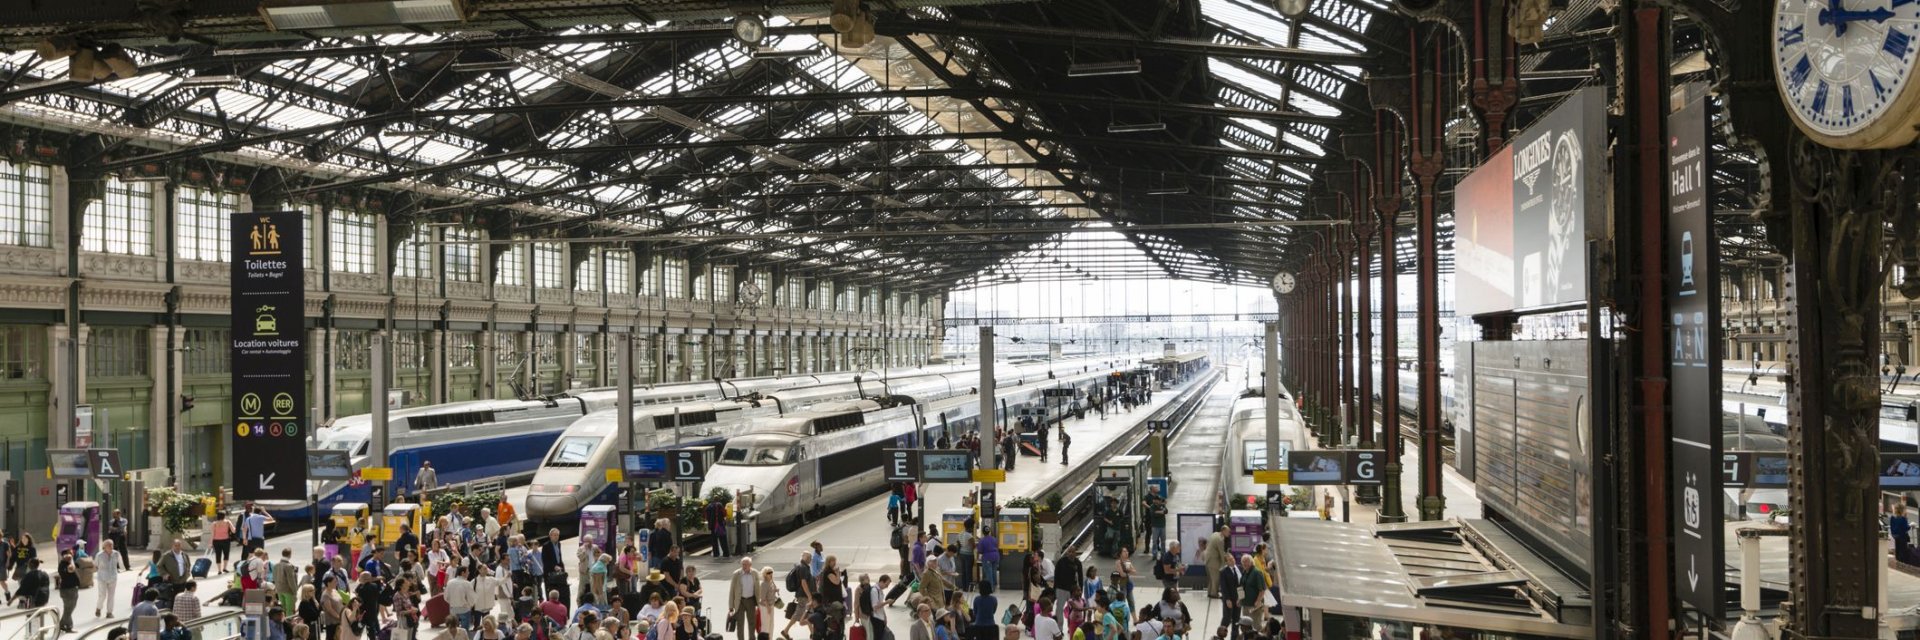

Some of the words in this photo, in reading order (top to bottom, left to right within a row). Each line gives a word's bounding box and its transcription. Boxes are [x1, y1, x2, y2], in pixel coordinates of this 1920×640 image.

[1514, 130, 1551, 181] LONGINES
[1672, 164, 1693, 197] Hall
[1695, 160, 1701, 188] 1
[244, 259, 287, 270] Toilettes
[233, 339, 267, 348] Location
[267, 338, 299, 347] voitures
[1674, 327, 1684, 360] A
[1694, 327, 1705, 360] N
[275, 399, 291, 409] RER
[254, 425, 264, 434] 14
[100, 457, 114, 474] A
[678, 458, 695, 476] D
[895, 458, 908, 476] E
[1356, 460, 1375, 479] G
